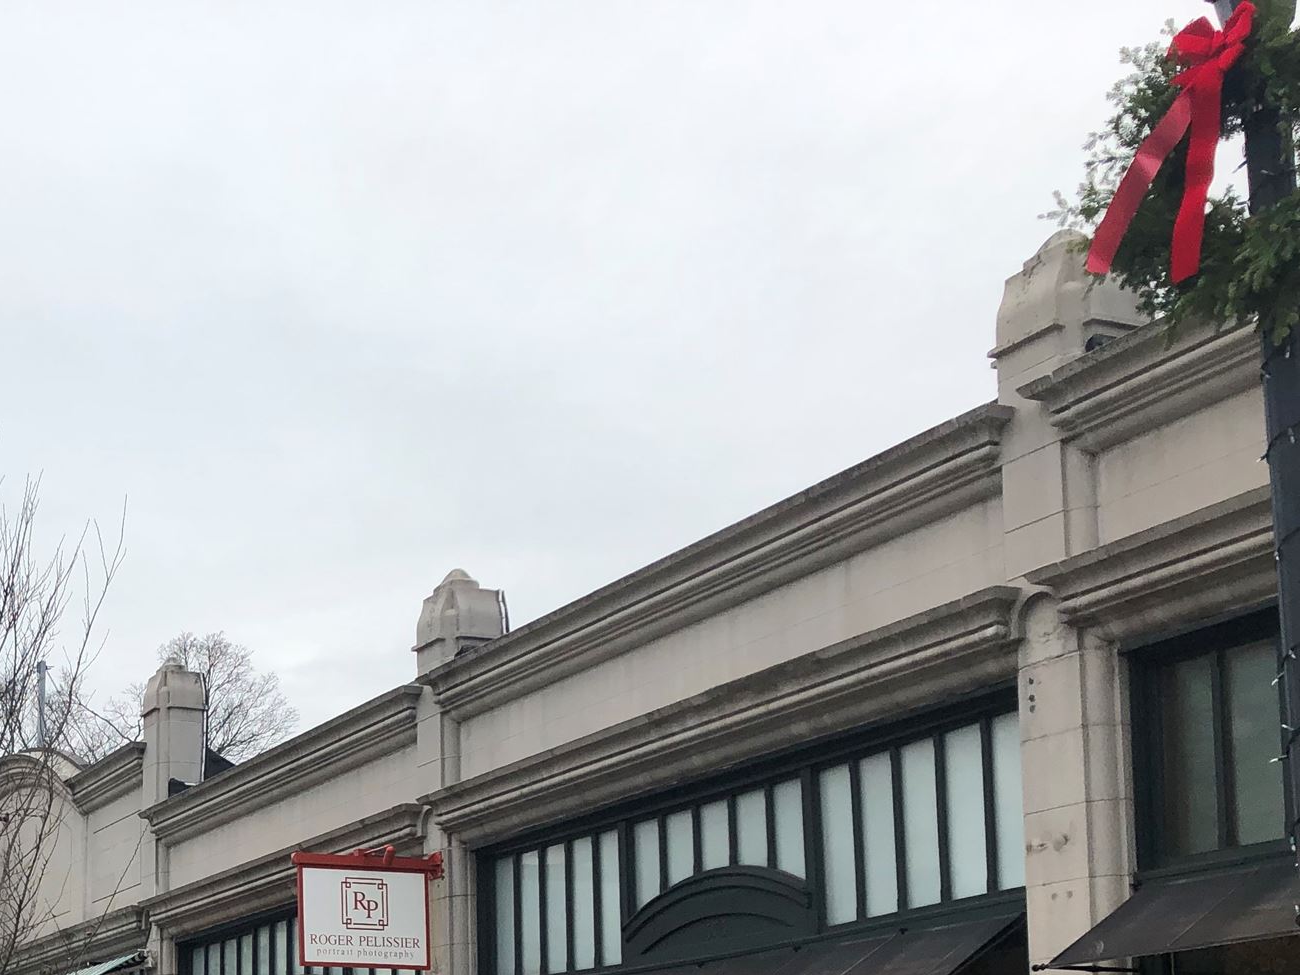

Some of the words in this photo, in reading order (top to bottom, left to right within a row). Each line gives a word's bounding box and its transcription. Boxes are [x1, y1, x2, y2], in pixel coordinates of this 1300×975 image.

[352, 891, 379, 919] RP
[309, 933, 354, 946] ROGER
[358, 935, 421, 949] PELISSIER
[316, 947, 354, 957] portrait
[357, 948, 415, 960] photography
